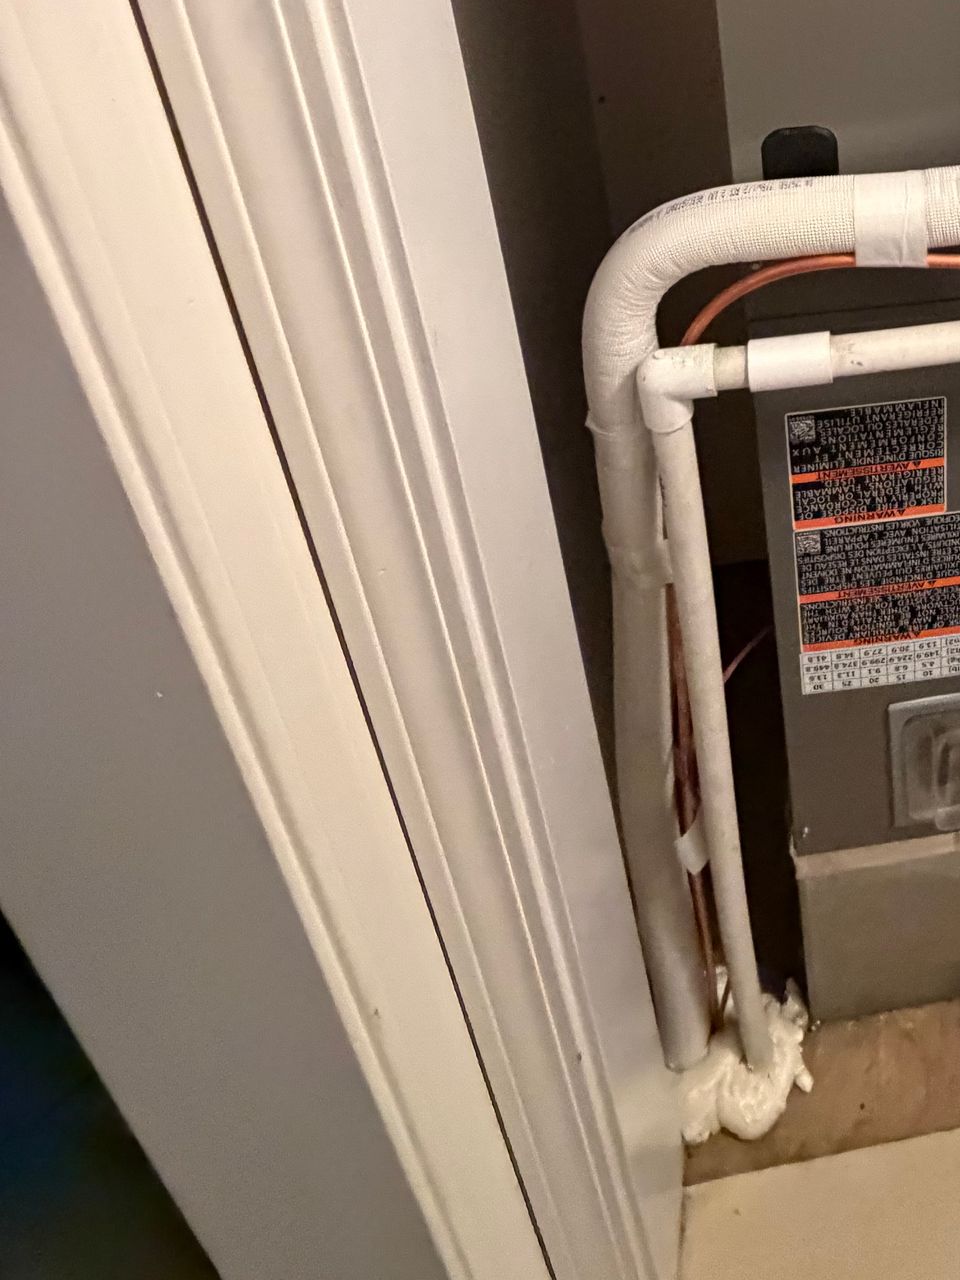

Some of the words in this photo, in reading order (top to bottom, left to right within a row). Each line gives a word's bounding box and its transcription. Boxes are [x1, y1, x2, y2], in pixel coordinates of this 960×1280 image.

[866, 421, 882, 431] OU
[791, 445, 821, 457] AUX
[836, 440, 943, 460] CORRECTEMENT
[908, 447, 943, 459] RISQUE
[814, 453, 828, 462] ET
[815, 461, 910, 480] AVERTISSEMENT
[863, 466, 943, 482] REFRIGERANT
[794, 483, 860, 498] FLAMMABLE
[856, 485, 906, 498] FEDERAL
[914, 481, 943, 491] WITH
[795, 494, 830, 506] LOCAL
[838, 491, 853, 500] OR
[875, 495, 886, 503] IN
[890, 488, 943, 501] PROPERLY
[919, 495, 943, 505] RISK
[795, 497, 870, 513] ACCORDANCE
[902, 498, 916, 507] OF
[798, 511, 813, 520] OF
[821, 504, 866, 517] DISPOSE
[834, 510, 895, 523] WARNING
[882, 528, 906, 538] AVEC
[836, 581, 925, 598] AVERTISSEMENT
[853, 631, 911, 645] WARNING
